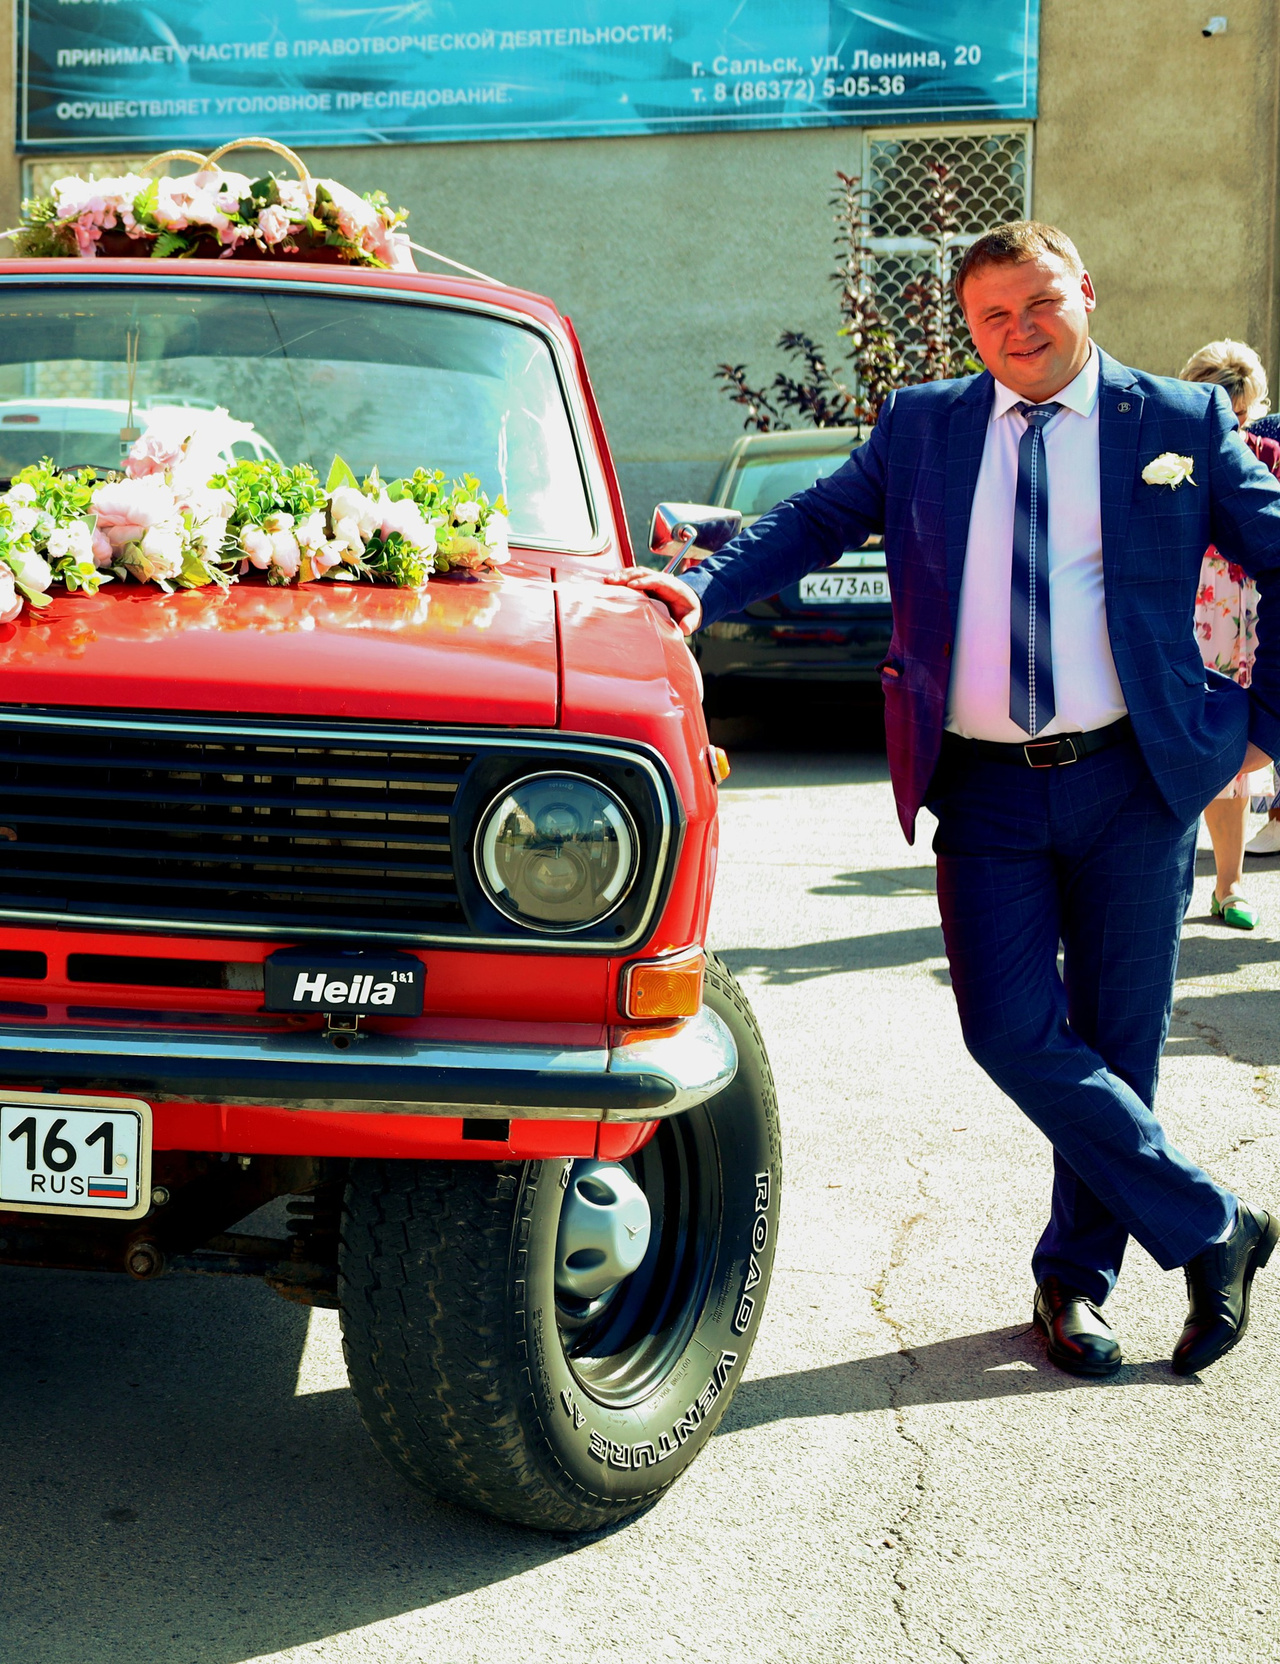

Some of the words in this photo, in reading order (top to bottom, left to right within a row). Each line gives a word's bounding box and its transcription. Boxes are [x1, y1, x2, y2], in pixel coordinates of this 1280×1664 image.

[57, 46, 174, 67] ПРИНИМАЕТ
[177, 42, 269, 64] УЧАСТИЕ
[275, 41, 288, 58] В
[294, 28, 495, 56] ПРАВОТВОРЧЕСКОЙ
[500, 24, 673, 51] ДЕЯТЕЛЬНОСТИ;
[692, 62, 706, 77] г.
[713, 56, 804, 75] Сальск,
[811, 55, 845, 76] ул.
[853, 50, 947, 70] Ленина,
[954, 45, 981, 65] 20
[56, 99, 211, 121] ОСУЩЕСТВЛЯЕТ
[216, 93, 331, 115] УГОЛОВНОЕ
[336, 87, 513, 110] ПРЕСЛЕДОВАНИЕ.
[691, 87, 706, 103] т.
[714, 83, 727, 101] 8
[733, 79, 815, 105] (86372)
[823, 76, 905, 97] 5-05-36
[806, 577, 884, 597] К473АВ
[8, 1116, 114, 1175] 161
[31, 1174, 85, 1196] RUS
[734, 1169, 771, 1334] ROAD
[588, 1349, 738, 1468] VENTURE
